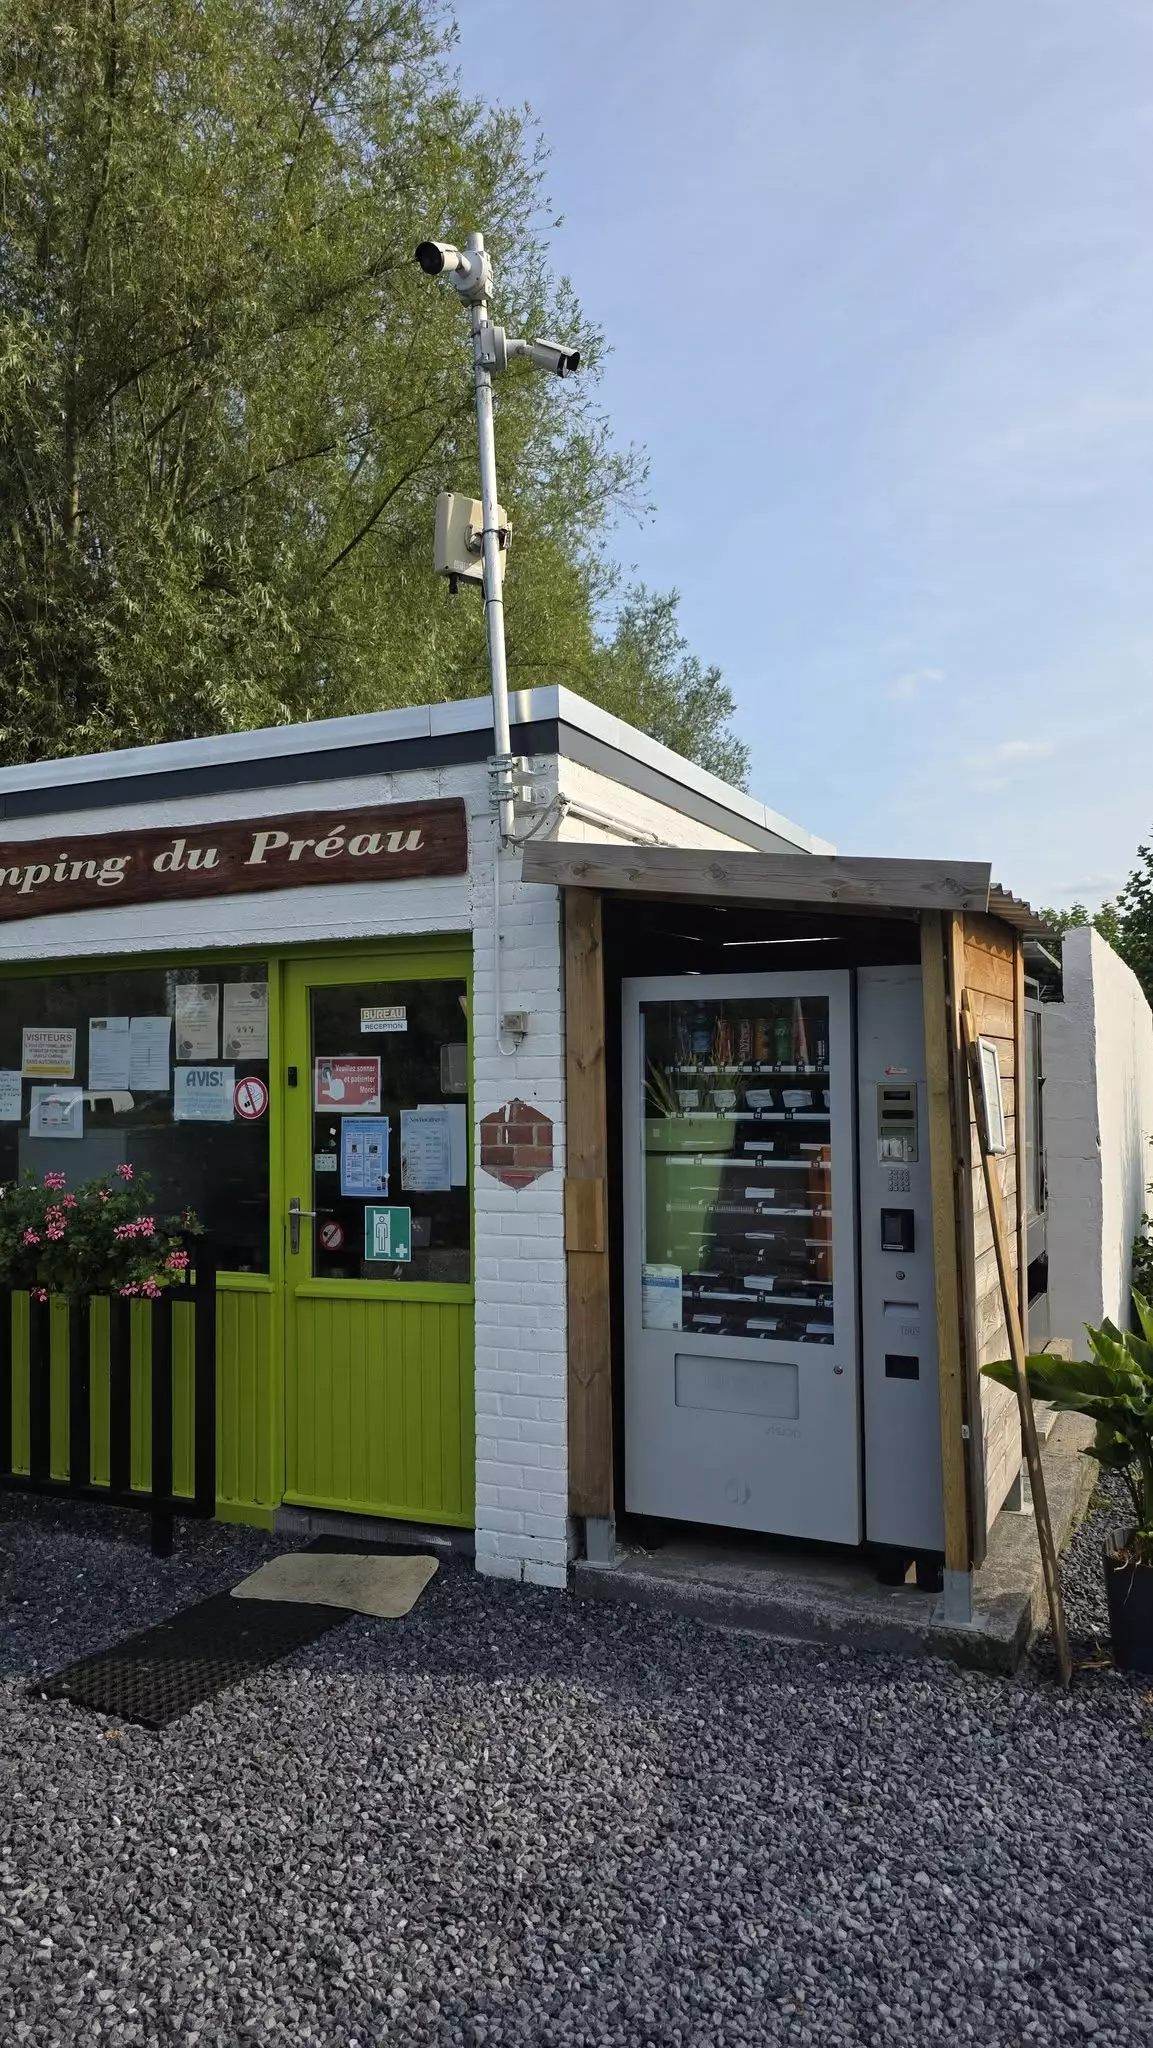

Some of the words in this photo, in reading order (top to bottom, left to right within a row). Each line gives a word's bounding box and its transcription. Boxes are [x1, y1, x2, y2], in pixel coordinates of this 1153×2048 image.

[153, 838, 220, 873] du
[243, 825, 425, 865] Préau
[363, 1008, 404, 1020] BUREAU
[364, 1022, 404, 1030] RECEPTION
[25, 1033, 73, 1042] VISITEURS
[335, 1064, 356, 1072] Veuillez
[186, 1071, 224, 1087] AVIS!
[350, 1075, 375, 1084] patienter
[359, 1085, 375, 1094] Merci
